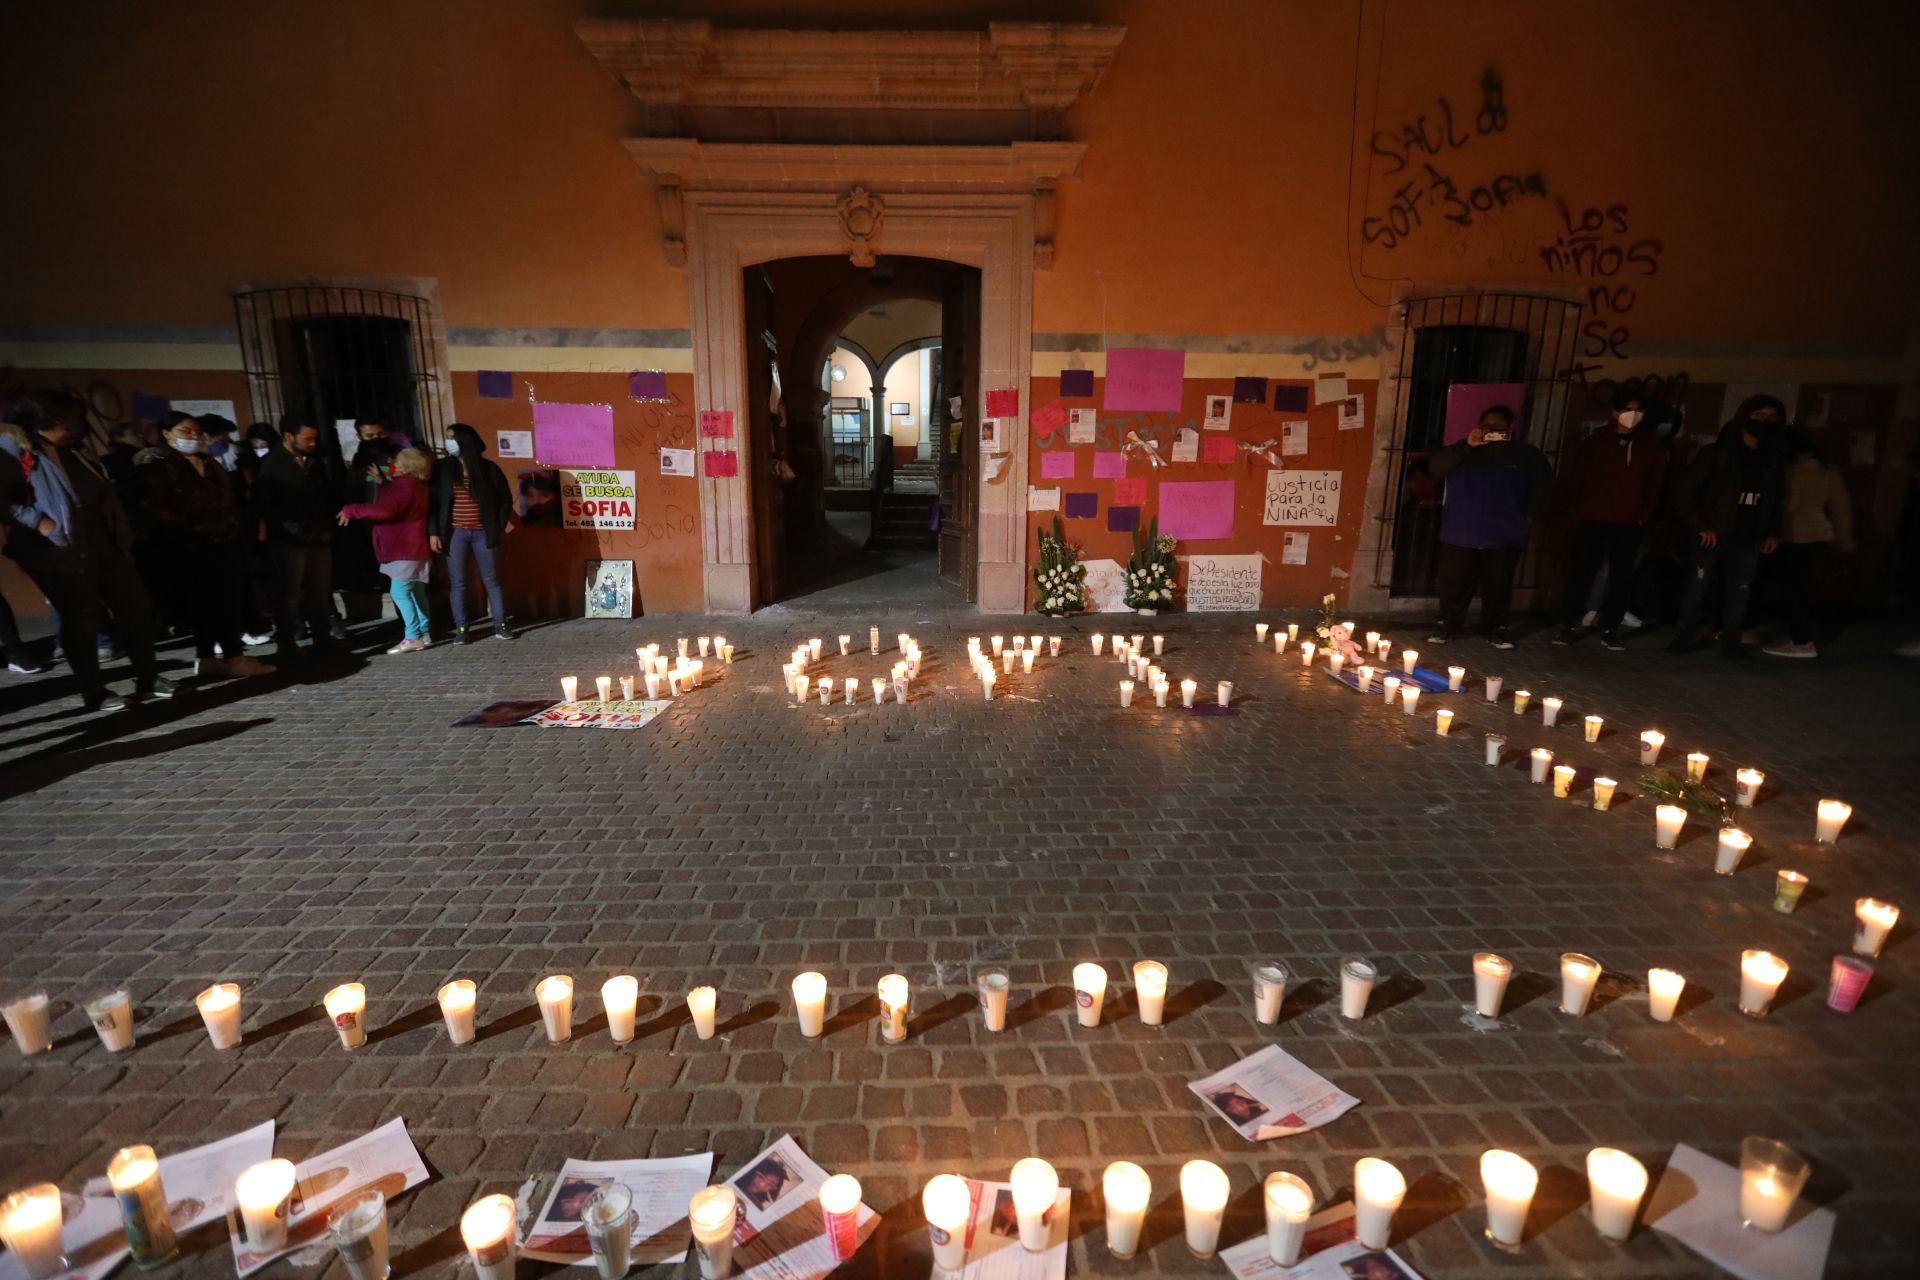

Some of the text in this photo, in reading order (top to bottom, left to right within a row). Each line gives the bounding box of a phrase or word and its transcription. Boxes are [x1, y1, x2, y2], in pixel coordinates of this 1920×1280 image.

[1588, 284, 1636, 316] no
[575, 472, 620, 484] AYUDA
[1268, 471, 1339, 494] Justicia
[562, 485, 582, 497] SE
[585, 486, 634, 498] BUSCA
[1312, 492, 1326, 504] la
[567, 500, 632, 517] SOFIA
[1267, 505, 1308, 522] NIÑA
[1207, 560, 1258, 580] Presidente
[1188, 596, 1222, 605] JUSTICIA
